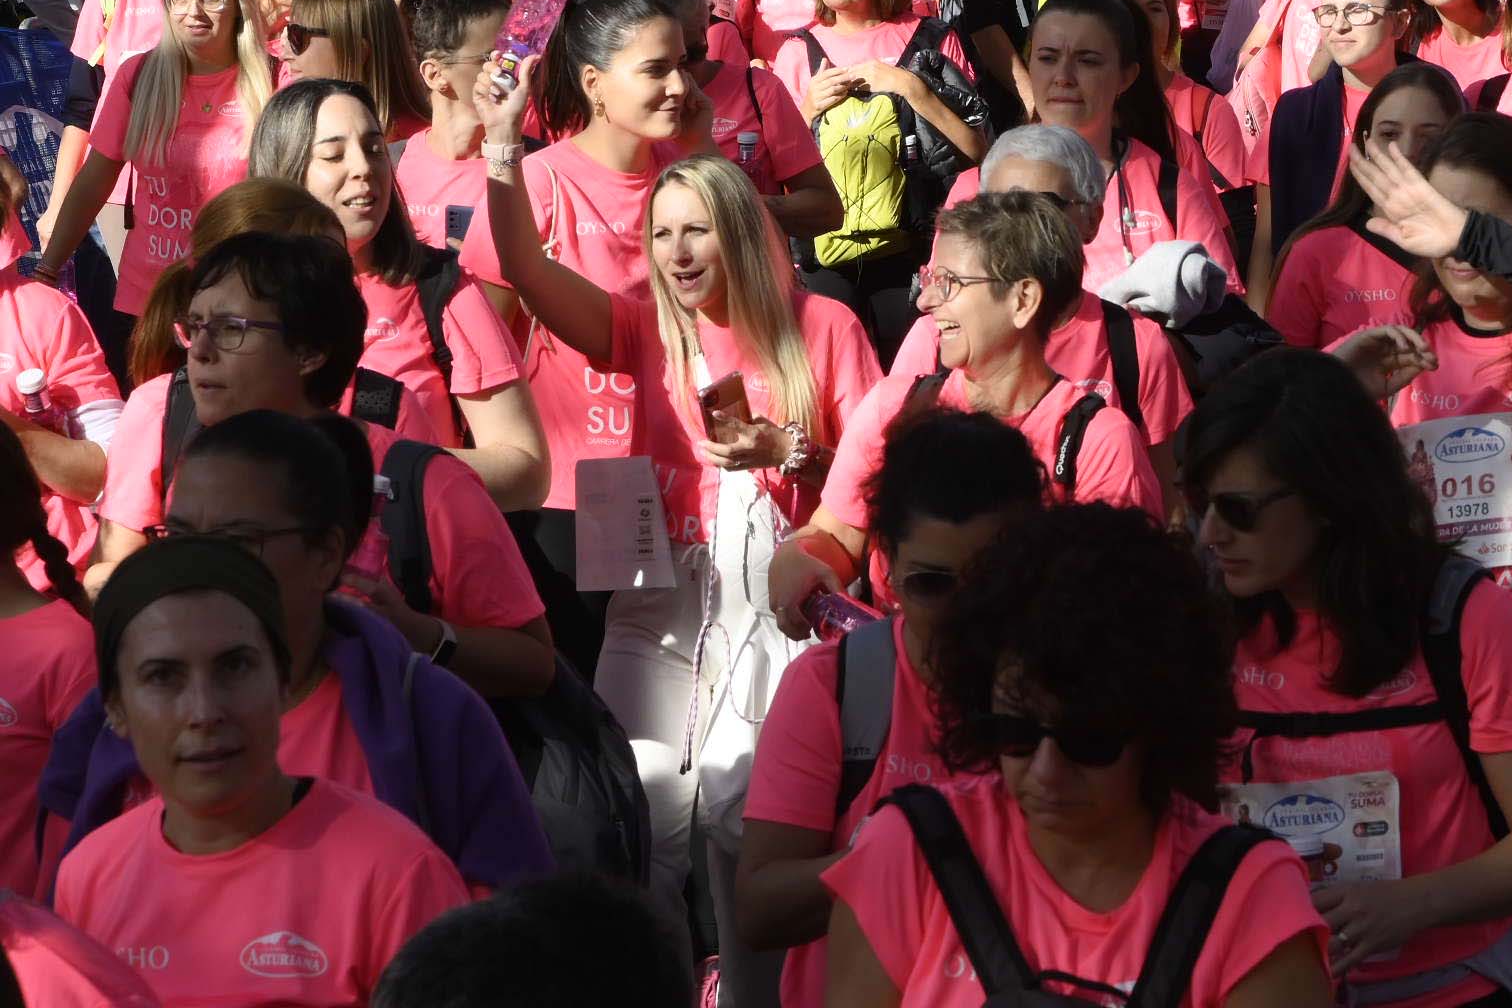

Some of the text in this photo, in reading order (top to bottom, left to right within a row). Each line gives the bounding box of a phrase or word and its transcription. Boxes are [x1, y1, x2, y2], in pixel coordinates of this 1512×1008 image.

[145, 175, 167, 197] TU
[1344, 288, 1396, 303] OYSHO
[1055, 434, 1072, 477] Quechua
[1440, 442, 1499, 458] ASTURIANA
[1441, 473, 1496, 498] 016
[1447, 502, 1490, 520] 13978
[1350, 797, 1386, 810] SUMA
[1269, 811, 1339, 828] ASTURIANA
[245, 948, 322, 973] ASTURIANA
